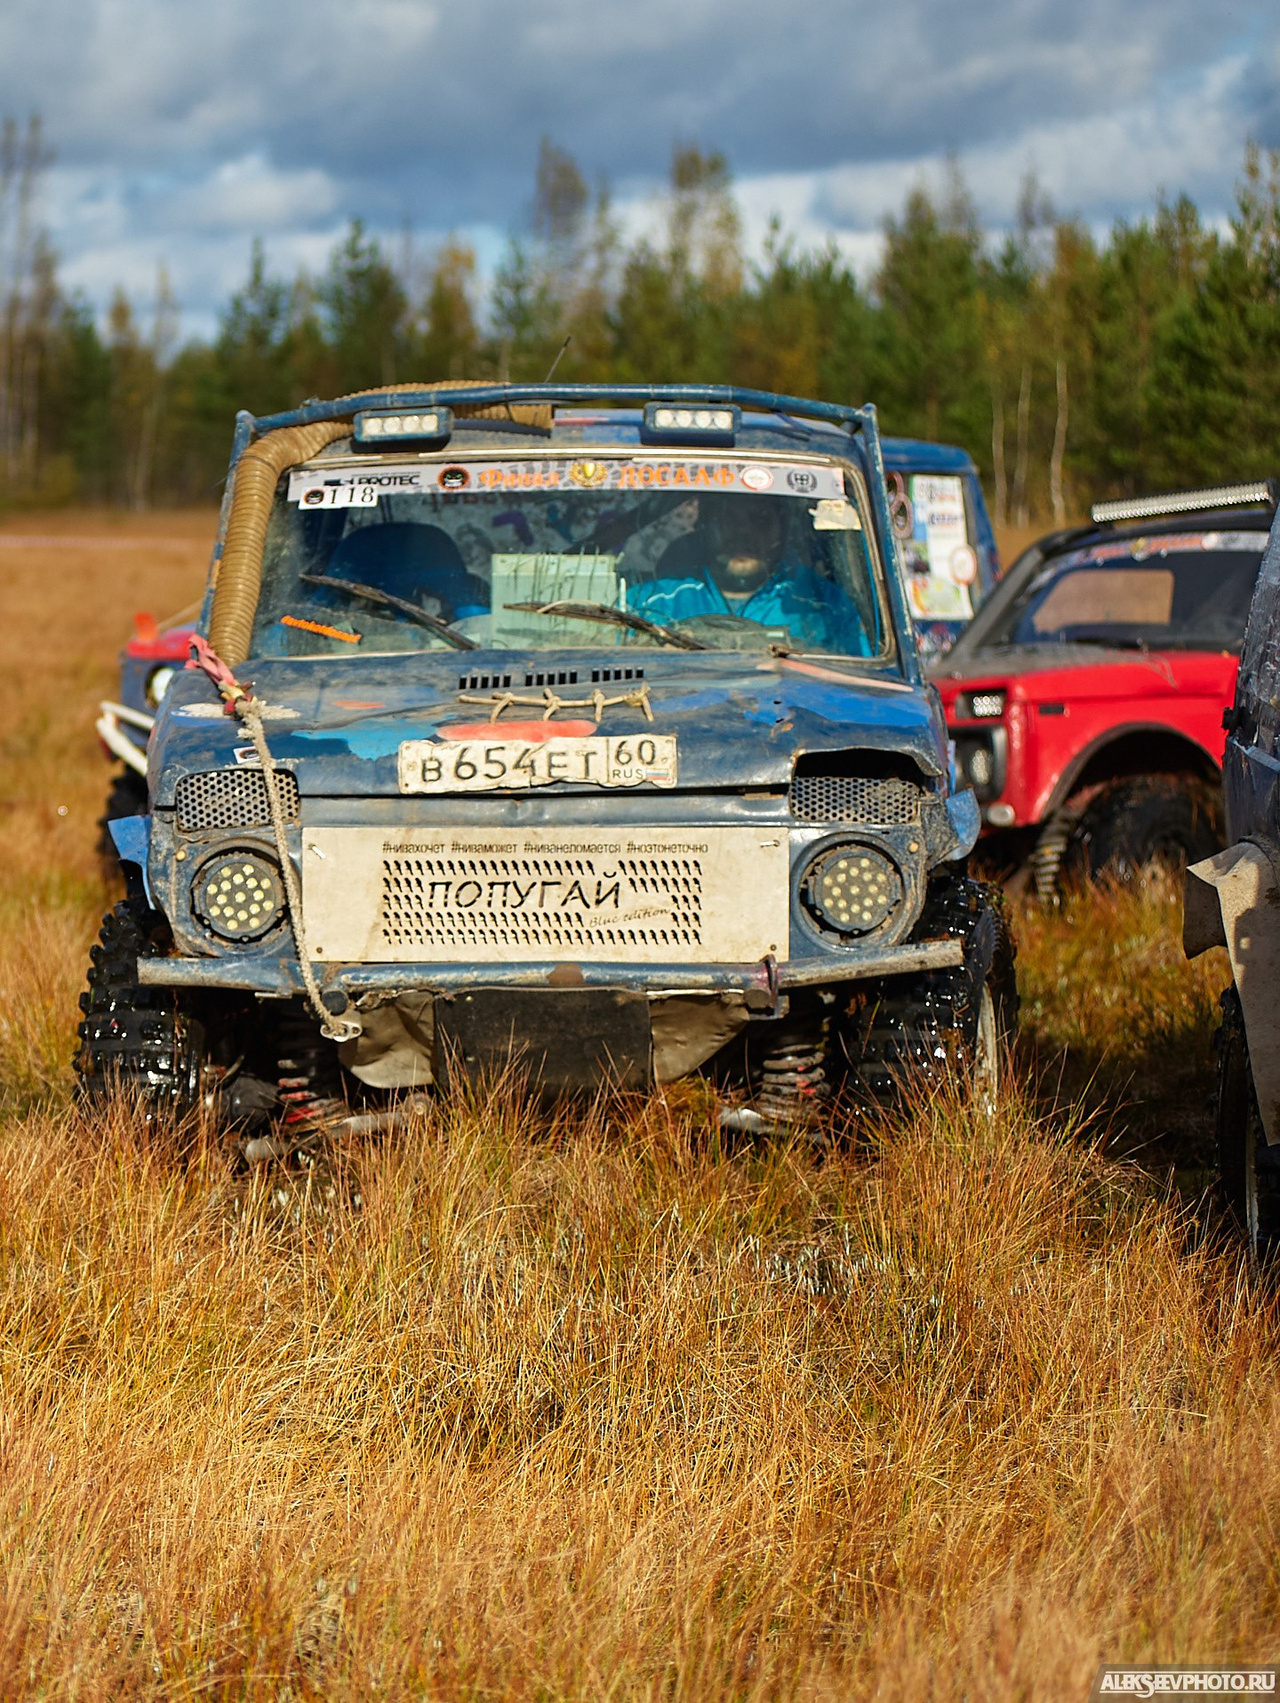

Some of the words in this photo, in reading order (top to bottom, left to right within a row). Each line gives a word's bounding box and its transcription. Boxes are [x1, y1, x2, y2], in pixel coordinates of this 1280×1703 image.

[331, 486, 375, 504] 118
[421, 746, 599, 782] В654ЕТ
[616, 740, 656, 765] 60
[612, 768, 644, 780] RUS
[428, 871, 620, 909] ПОПУГАЙ
